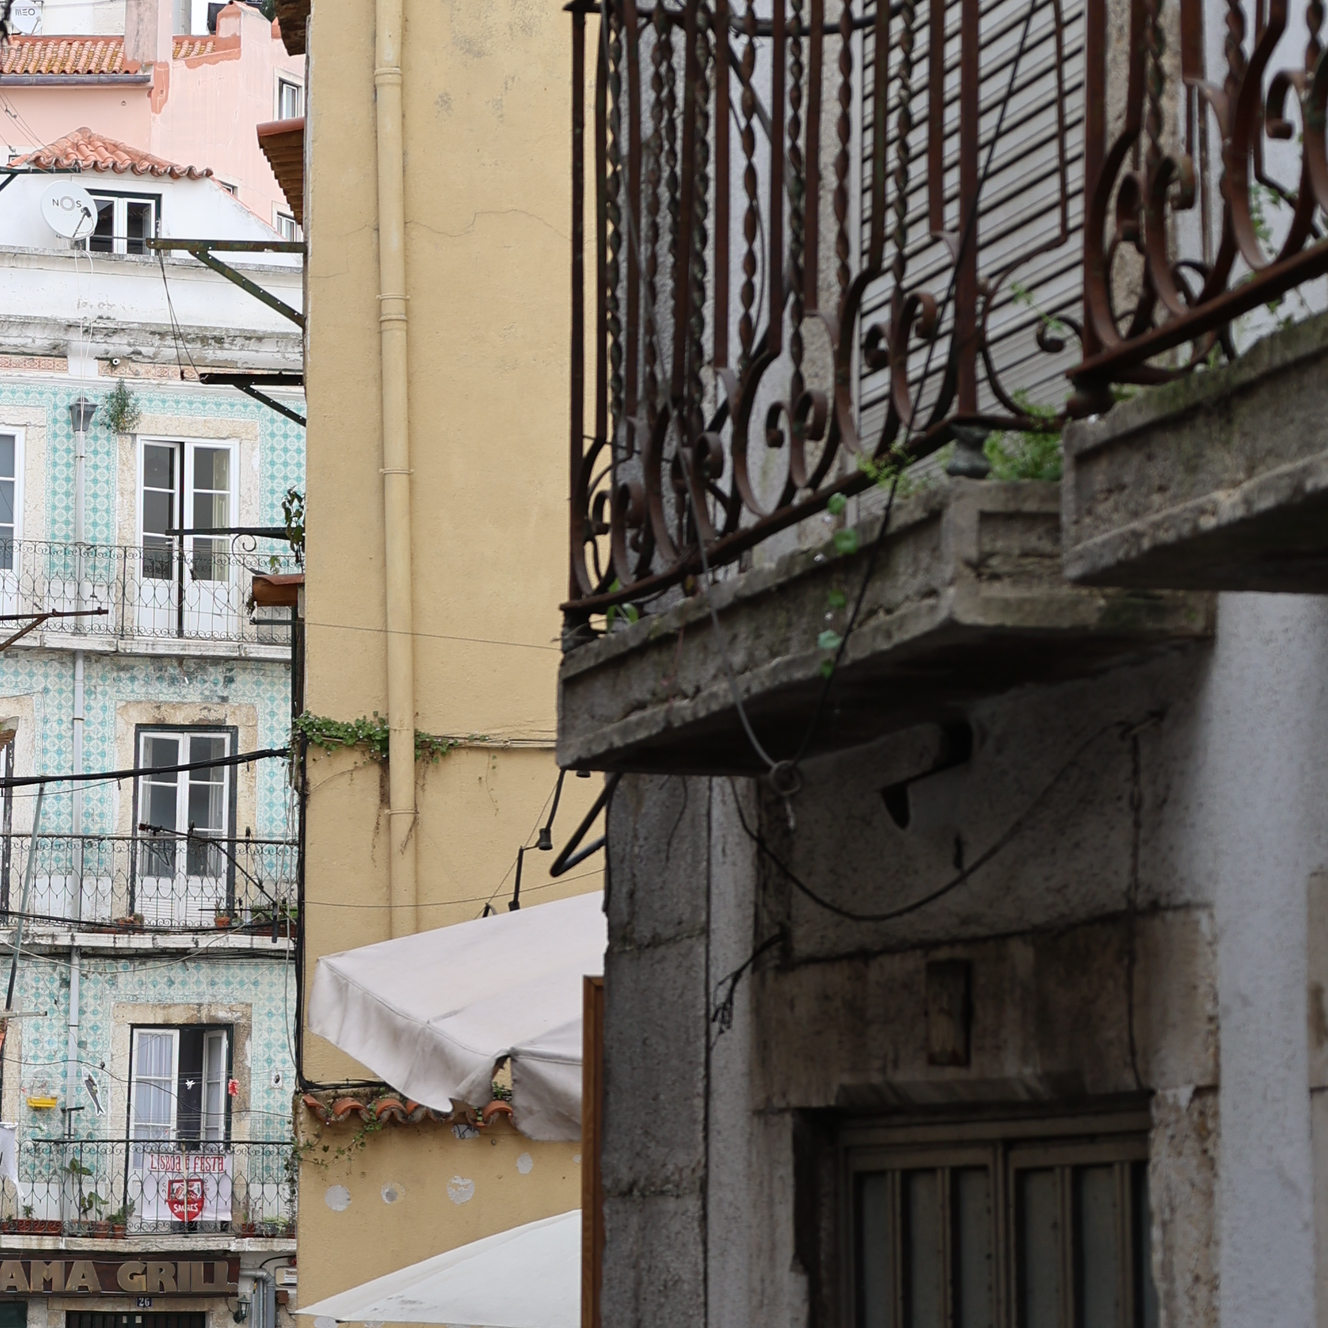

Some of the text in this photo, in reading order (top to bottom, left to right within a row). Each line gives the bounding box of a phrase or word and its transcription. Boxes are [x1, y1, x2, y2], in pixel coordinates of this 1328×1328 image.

[15, 8, 36, 17] MEO
[52, 195, 82, 211] NOS
[117, 1260, 238, 1292] GRILL
[138, 1297, 150, 1307] 26
